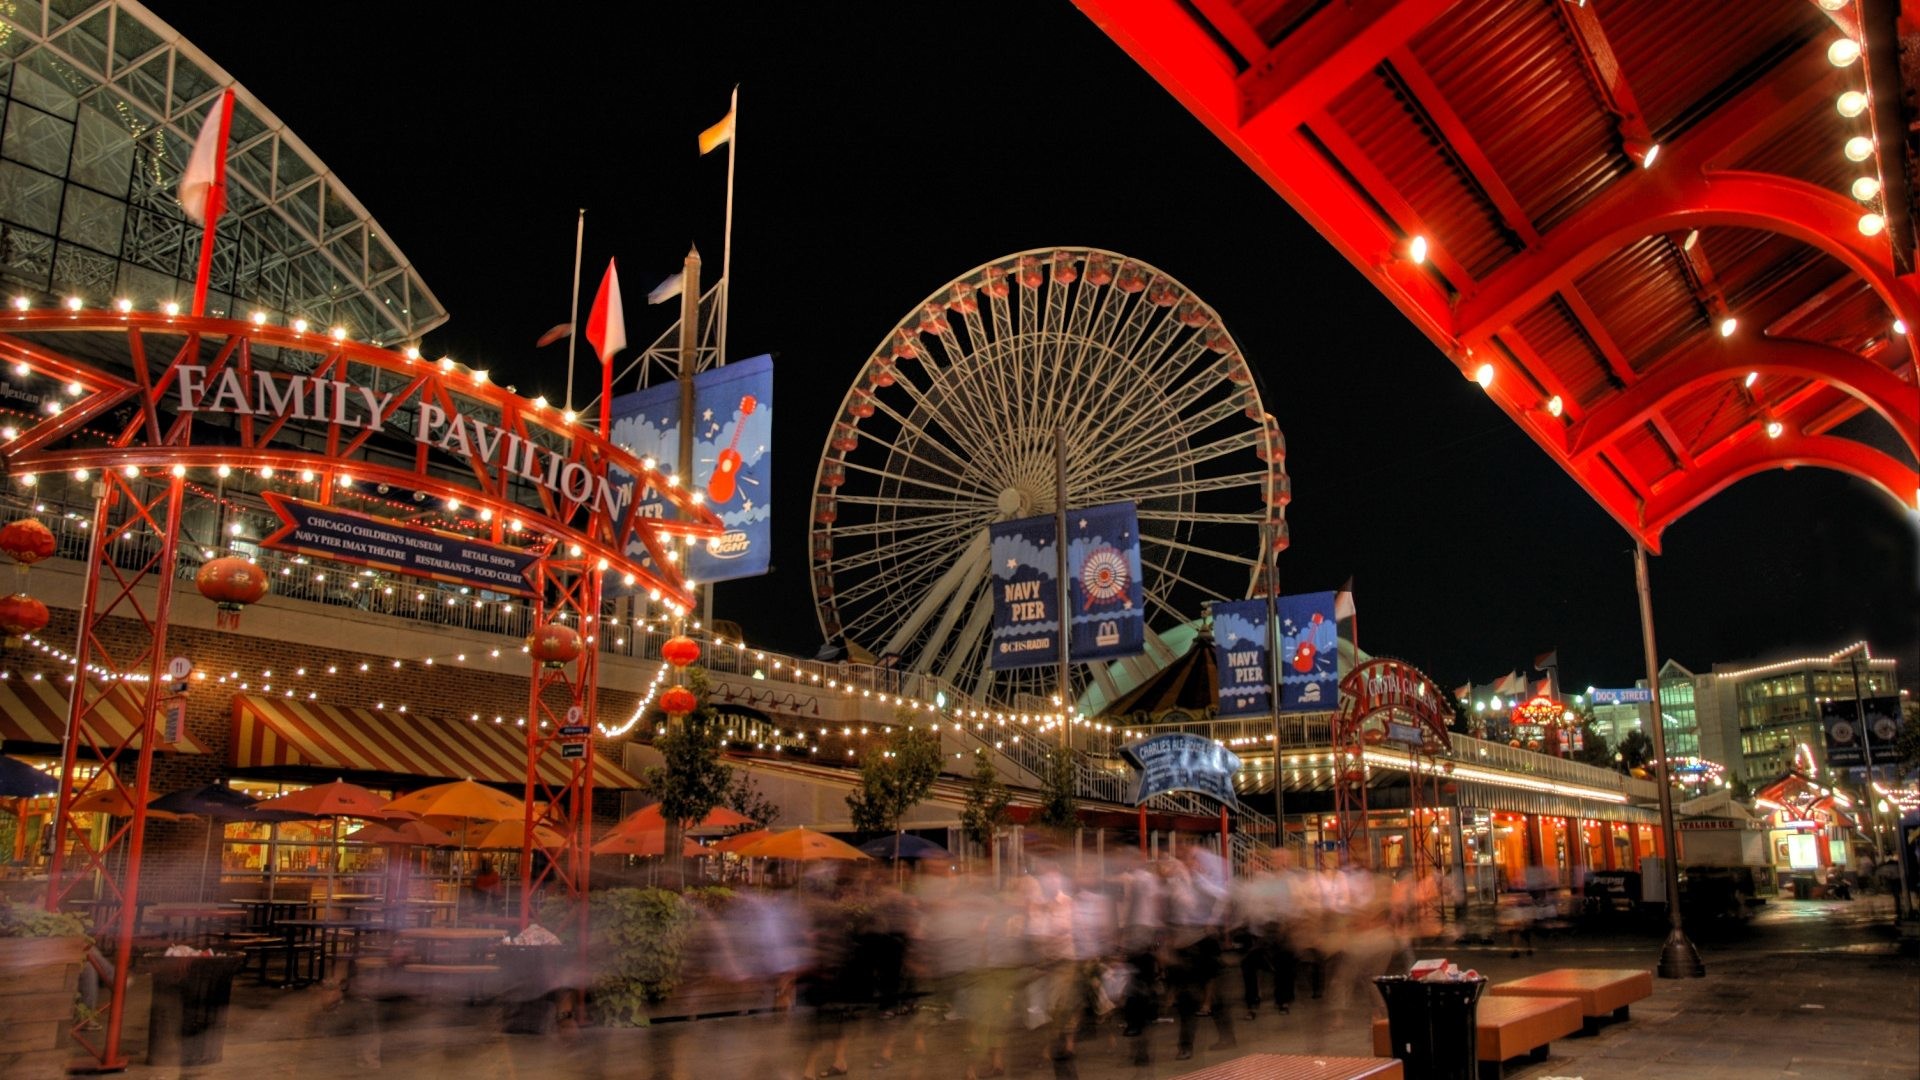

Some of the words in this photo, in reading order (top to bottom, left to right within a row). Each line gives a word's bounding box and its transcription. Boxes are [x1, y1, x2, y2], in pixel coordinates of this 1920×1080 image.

[174, 364, 393, 432] FAMILY
[414, 401, 624, 522] PAVILION
[307, 516, 352, 534] CHICAGO
[352, 526, 404, 544] CHILDREN'S
[405, 537, 443, 553] MUSEUM
[295, 530, 320, 543] NAVY
[320, 536, 341, 547] PIER
[342, 540, 367, 553] IMAX
[367, 545, 407, 560] THEATRE
[461, 549, 489, 563] RETAIL
[490, 555, 516, 568] SHOPS
[474, 566, 497, 578] FOOD
[497, 571, 522, 583] COURT
[1004, 581, 1041, 602] NAVY
[1011, 601, 1045, 622] PIER
[1227, 651, 1259, 667] NAVY
[1235, 667, 1263, 683] PIER
[1595, 691, 1617, 701] DOCK
[1620, 690, 1649, 701] STREET
[1718, 821, 1735, 829] ICE
